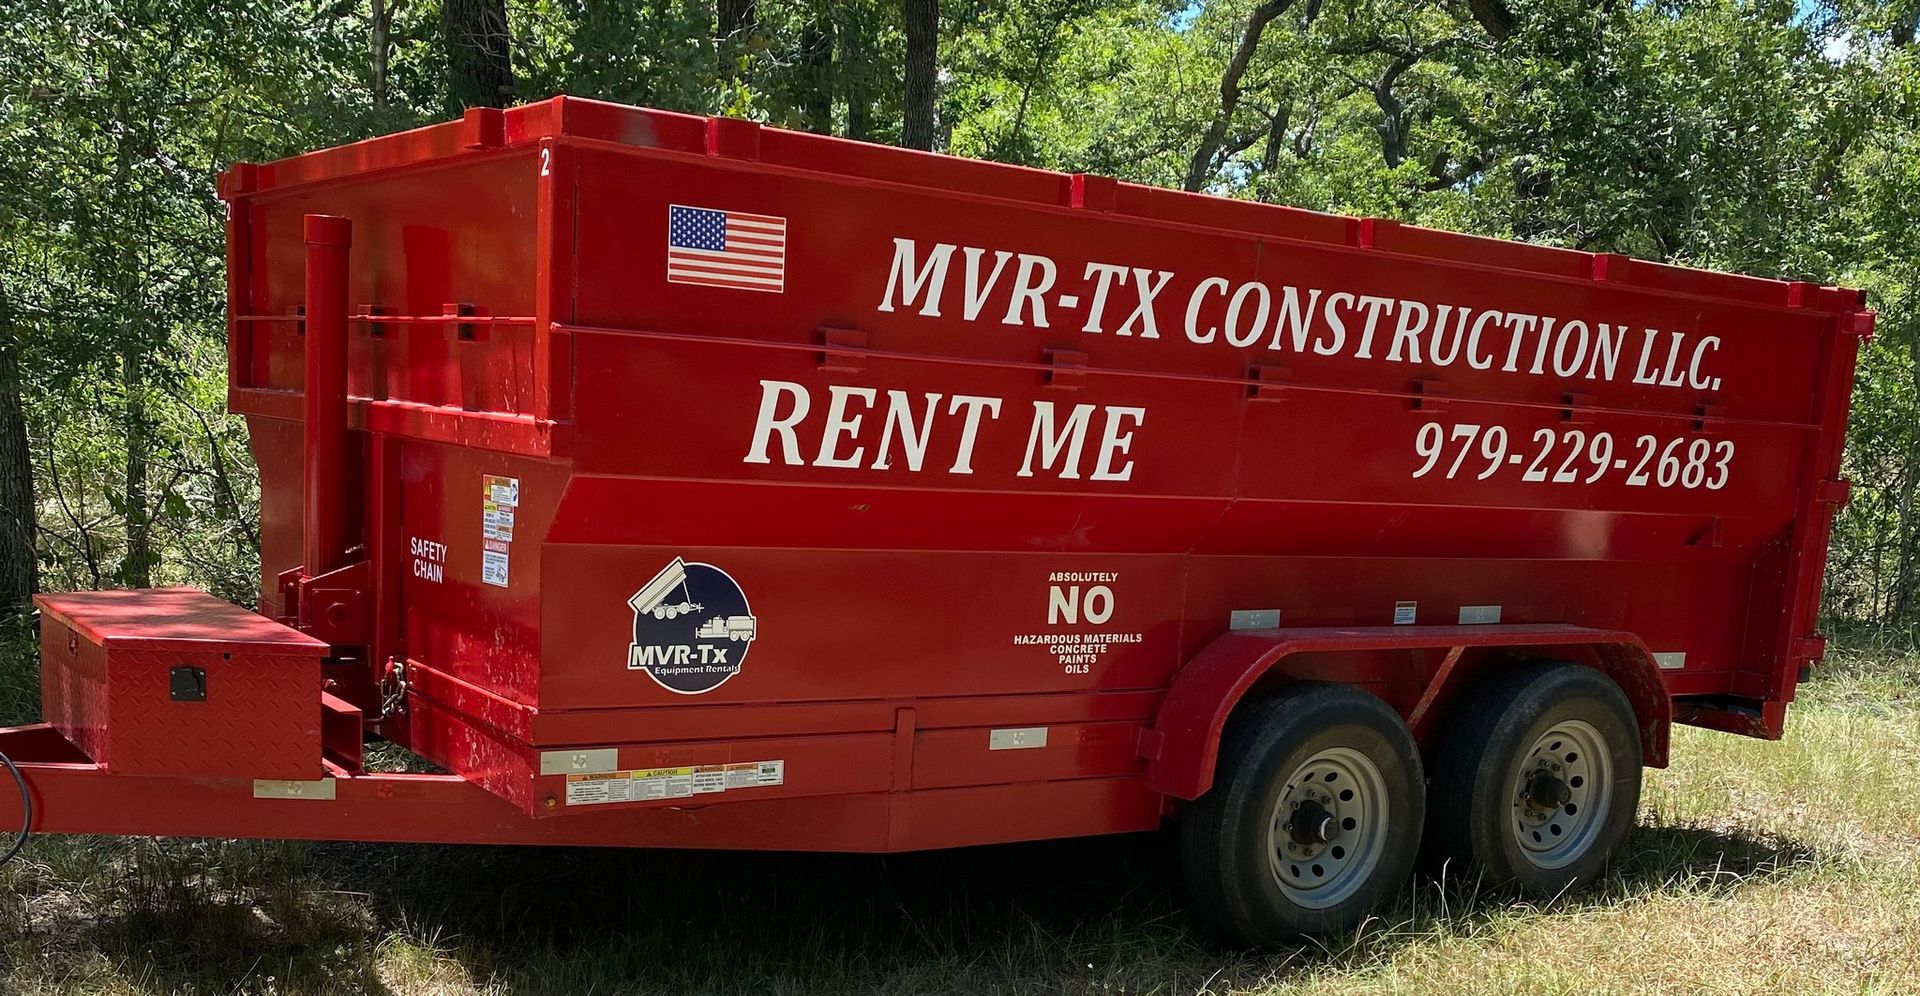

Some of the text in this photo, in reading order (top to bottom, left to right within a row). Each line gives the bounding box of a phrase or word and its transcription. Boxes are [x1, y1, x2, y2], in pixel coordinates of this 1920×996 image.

[541, 148, 550, 177] 2
[878, 238, 1721, 390] MVR-TX CONSTRUCTION LLC.
[744, 380, 1145, 481] RENT ME
[1412, 423, 1734, 489] 979-229-2683
[411, 536, 447, 563] SAFETY
[414, 559, 443, 584] CHAIN
[1049, 572, 1118, 582] ABSOLUTELY
[1048, 585, 1115, 625] NO
[1014, 633, 1142, 644] HAZARDOUS MATERIALS
[1050, 644, 1107, 654] CONCRETE
[631, 645, 728, 666] MVR-Tx
[1059, 654, 1097, 664] PAINTS
[655, 665, 739, 676] Equipment Rentals
[1065, 664, 1090, 674] OILS
[653, 769, 679, 777] CAUTION
